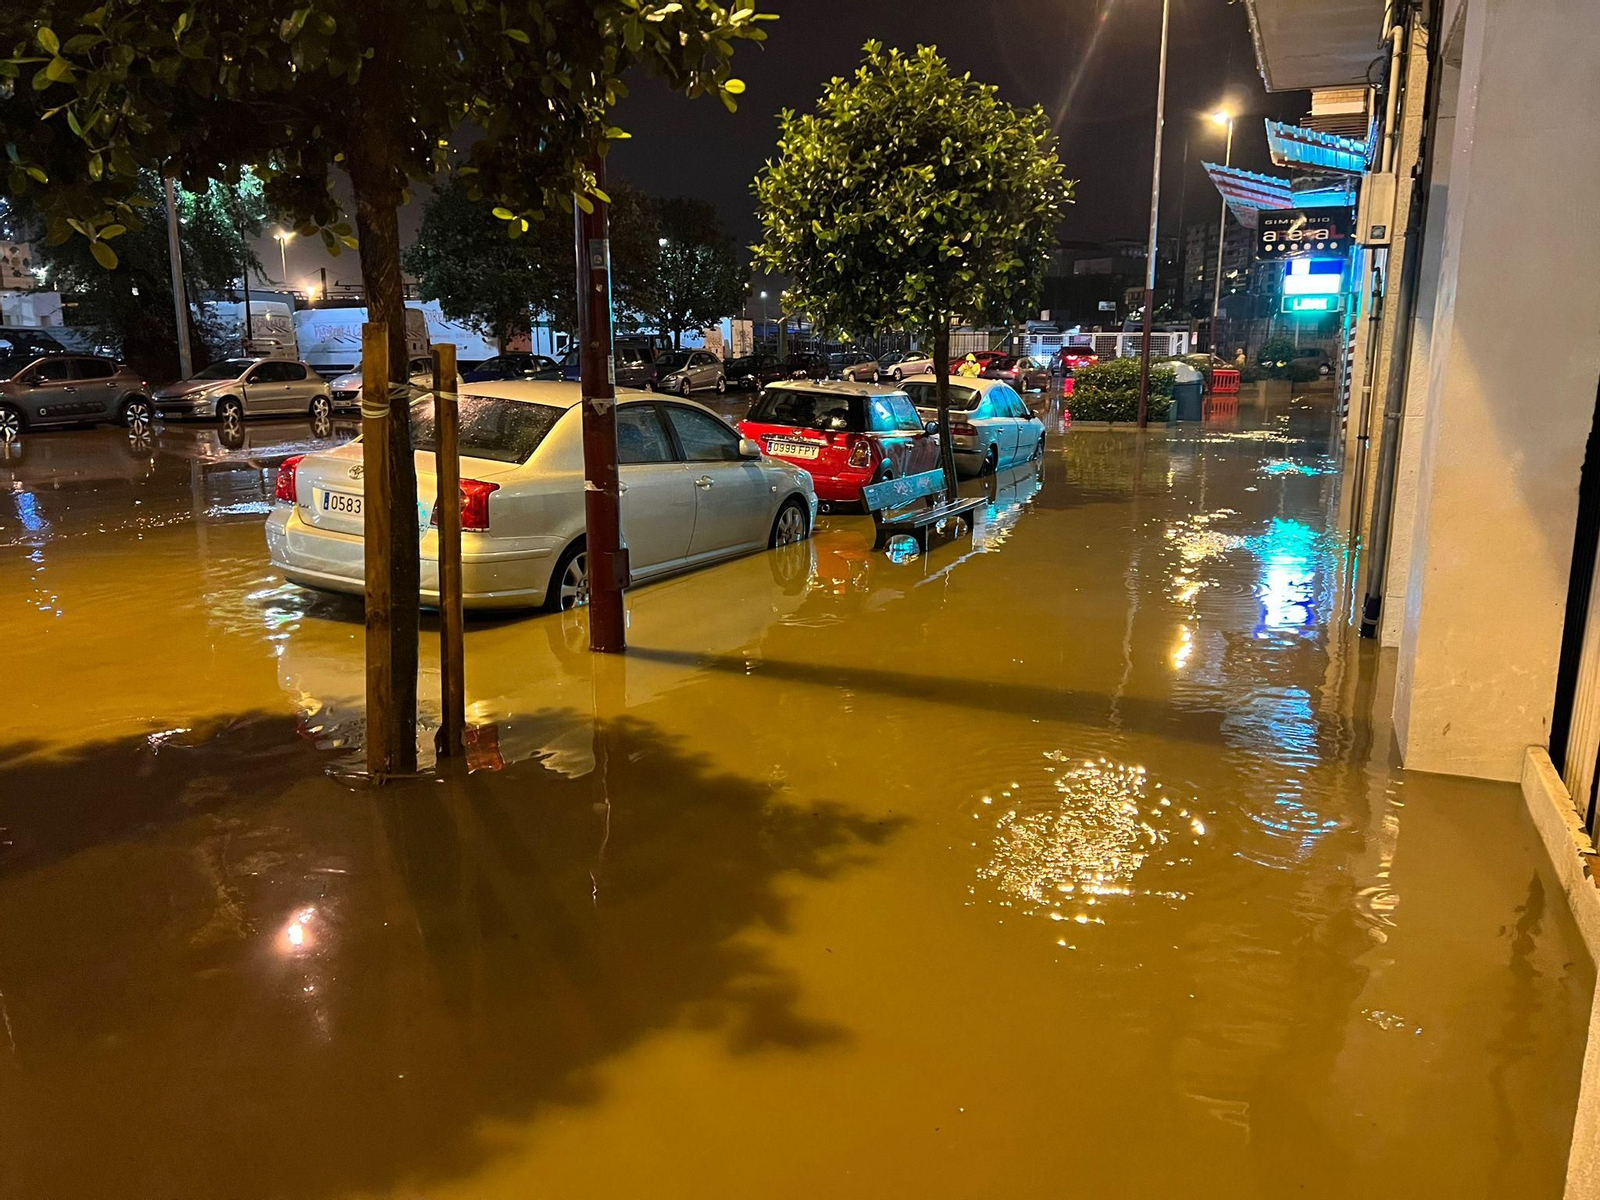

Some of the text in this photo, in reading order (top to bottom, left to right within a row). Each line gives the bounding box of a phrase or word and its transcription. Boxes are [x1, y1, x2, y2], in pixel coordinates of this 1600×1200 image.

[1264, 217, 1330, 225] GIMNSIO
[773, 442, 817, 457] 0999 FPY
[331, 495, 362, 514] 0583
